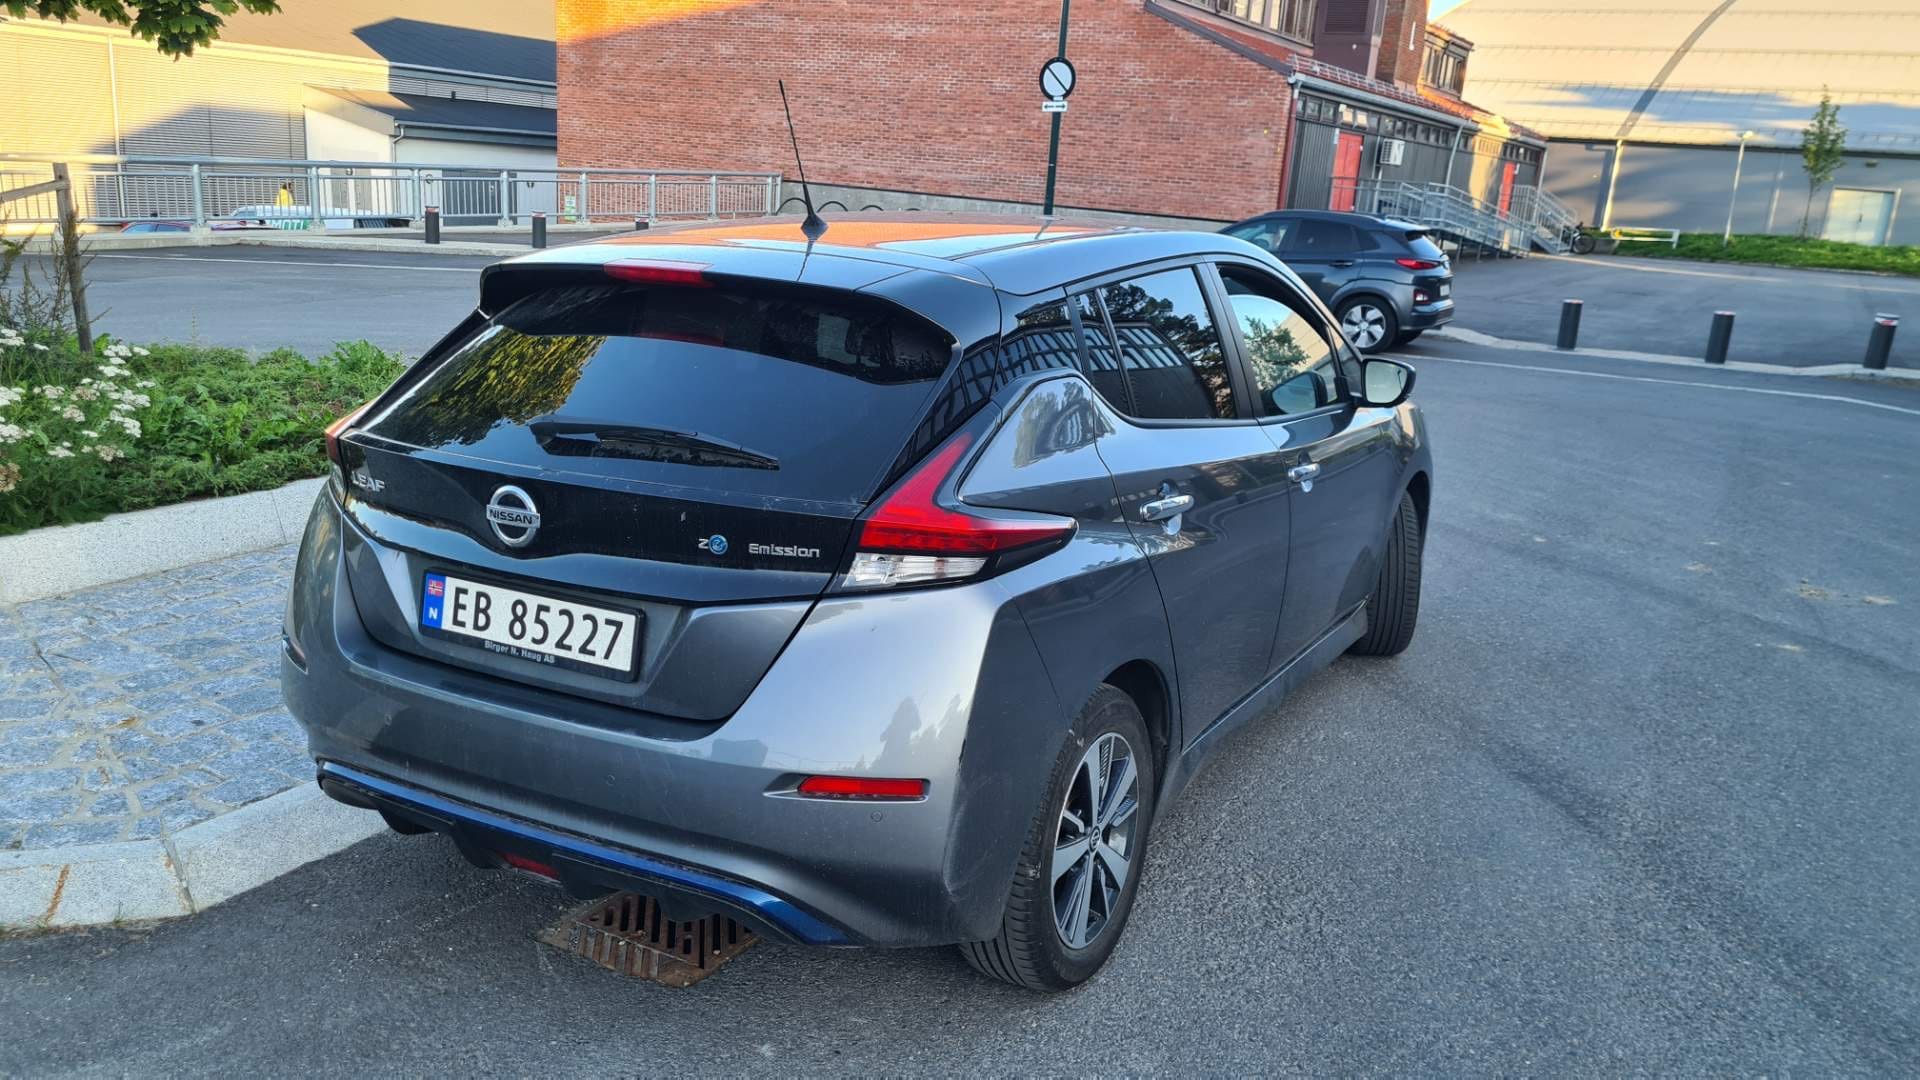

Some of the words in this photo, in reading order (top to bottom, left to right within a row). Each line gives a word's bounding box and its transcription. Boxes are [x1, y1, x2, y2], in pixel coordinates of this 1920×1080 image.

[352, 471, 385, 492] LEAF
[490, 509, 533, 525] NISSAN
[748, 543, 820, 558] Emission
[428, 607, 438, 620] N
[452, 586, 492, 632] EB
[508, 599, 624, 660] 85227
[484, 640, 509, 653] Birger
